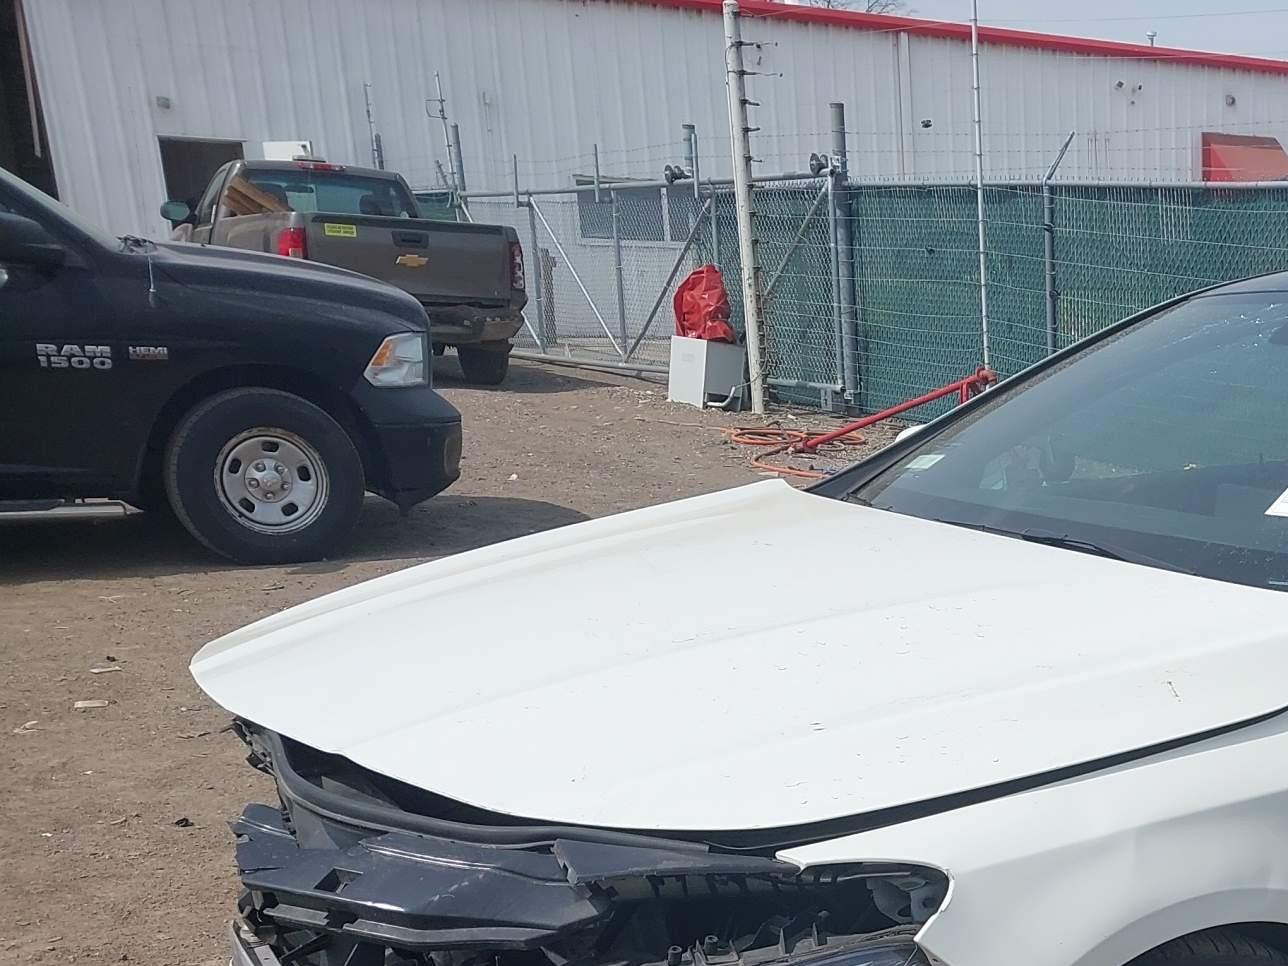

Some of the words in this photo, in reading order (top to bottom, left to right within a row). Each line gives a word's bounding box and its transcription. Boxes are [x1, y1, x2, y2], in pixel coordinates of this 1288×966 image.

[36, 344, 112, 356] RAM
[128, 346, 169, 354] HEMI
[38, 355, 113, 369] 1500
